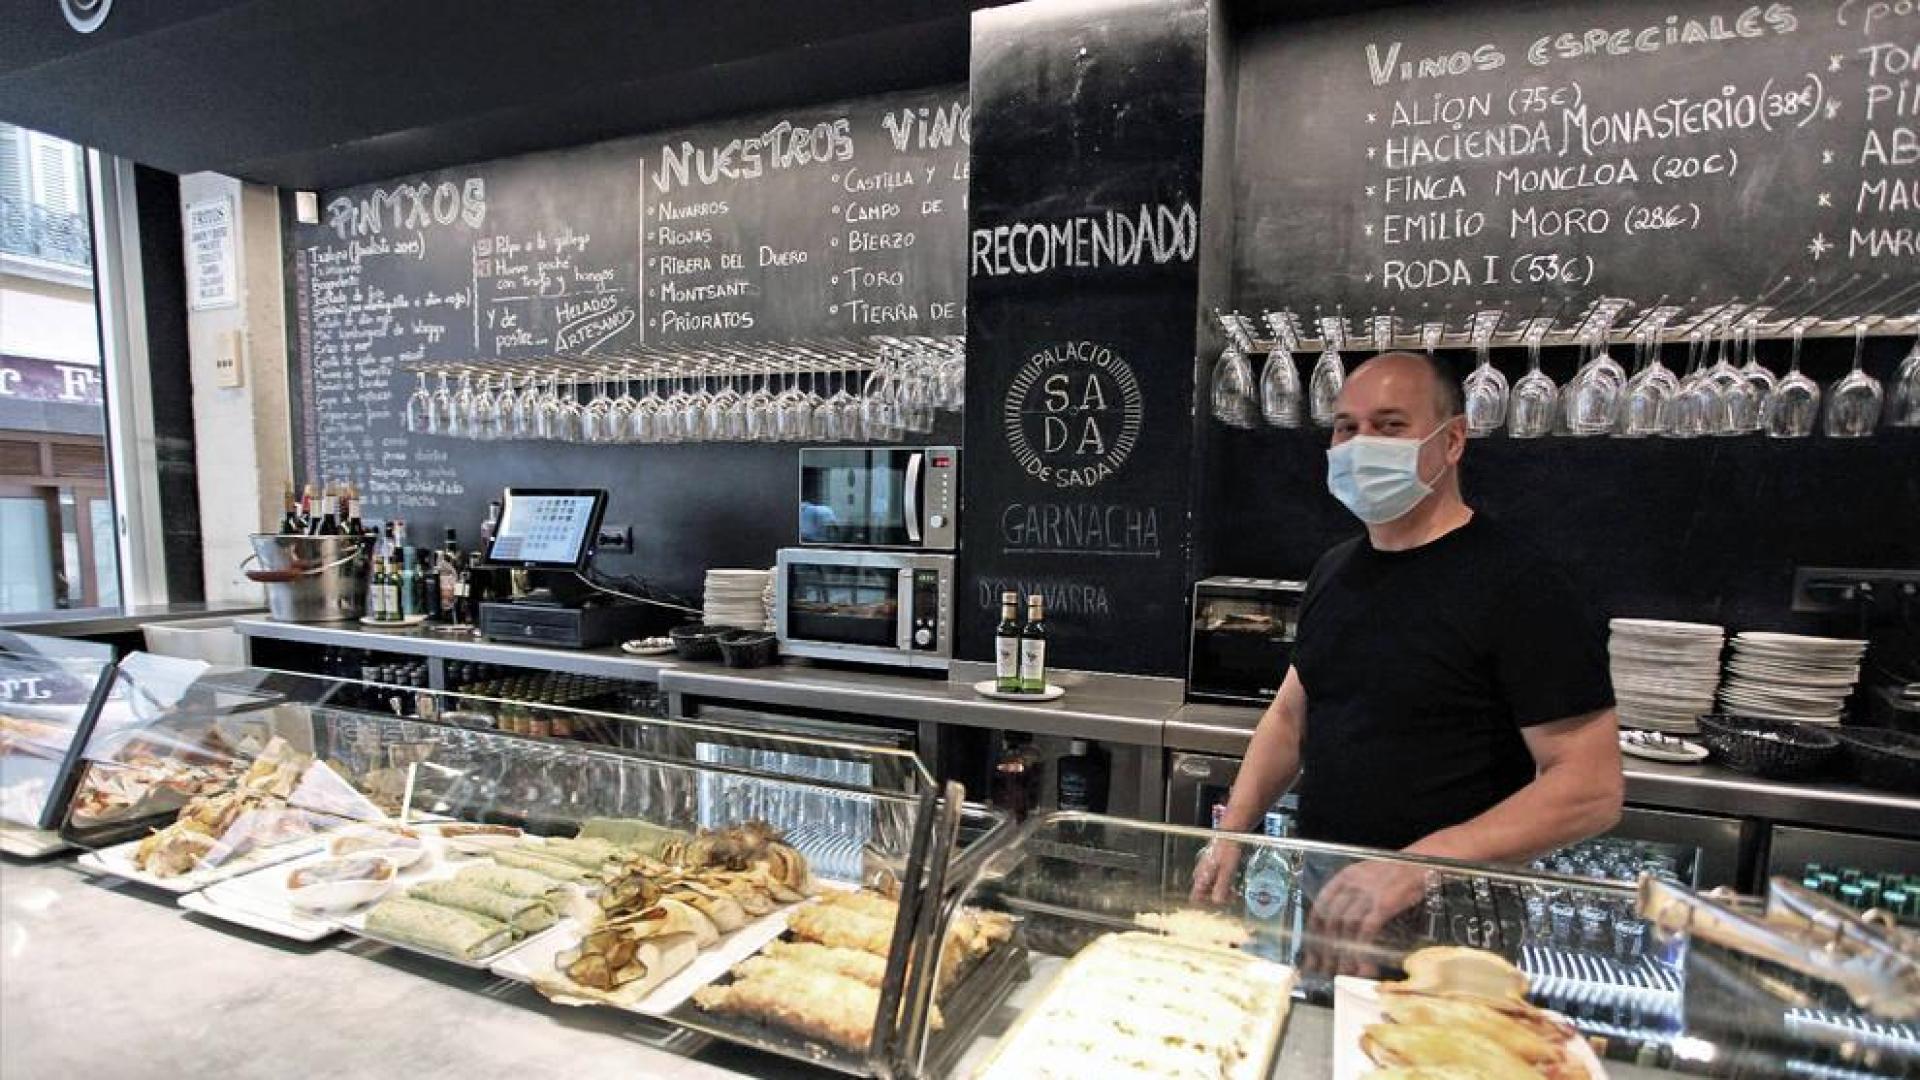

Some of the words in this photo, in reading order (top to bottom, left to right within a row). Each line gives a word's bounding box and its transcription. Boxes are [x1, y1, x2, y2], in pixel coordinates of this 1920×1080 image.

[653, 118, 854, 192] NUESTROS
[1496, 165, 1638, 196] MONCLOA
[972, 202, 1197, 276] RECOMENDADO
[1510, 206, 1610, 239] MORO
[843, 267, 903, 292] TORO
[1384, 259, 1471, 291] RODA
[1031, 341, 1111, 374] PALACIO
[1025, 455, 1051, 482] DE
[1056, 463, 1113, 488] SADA
[1003, 503, 1159, 548] GARNACHA
